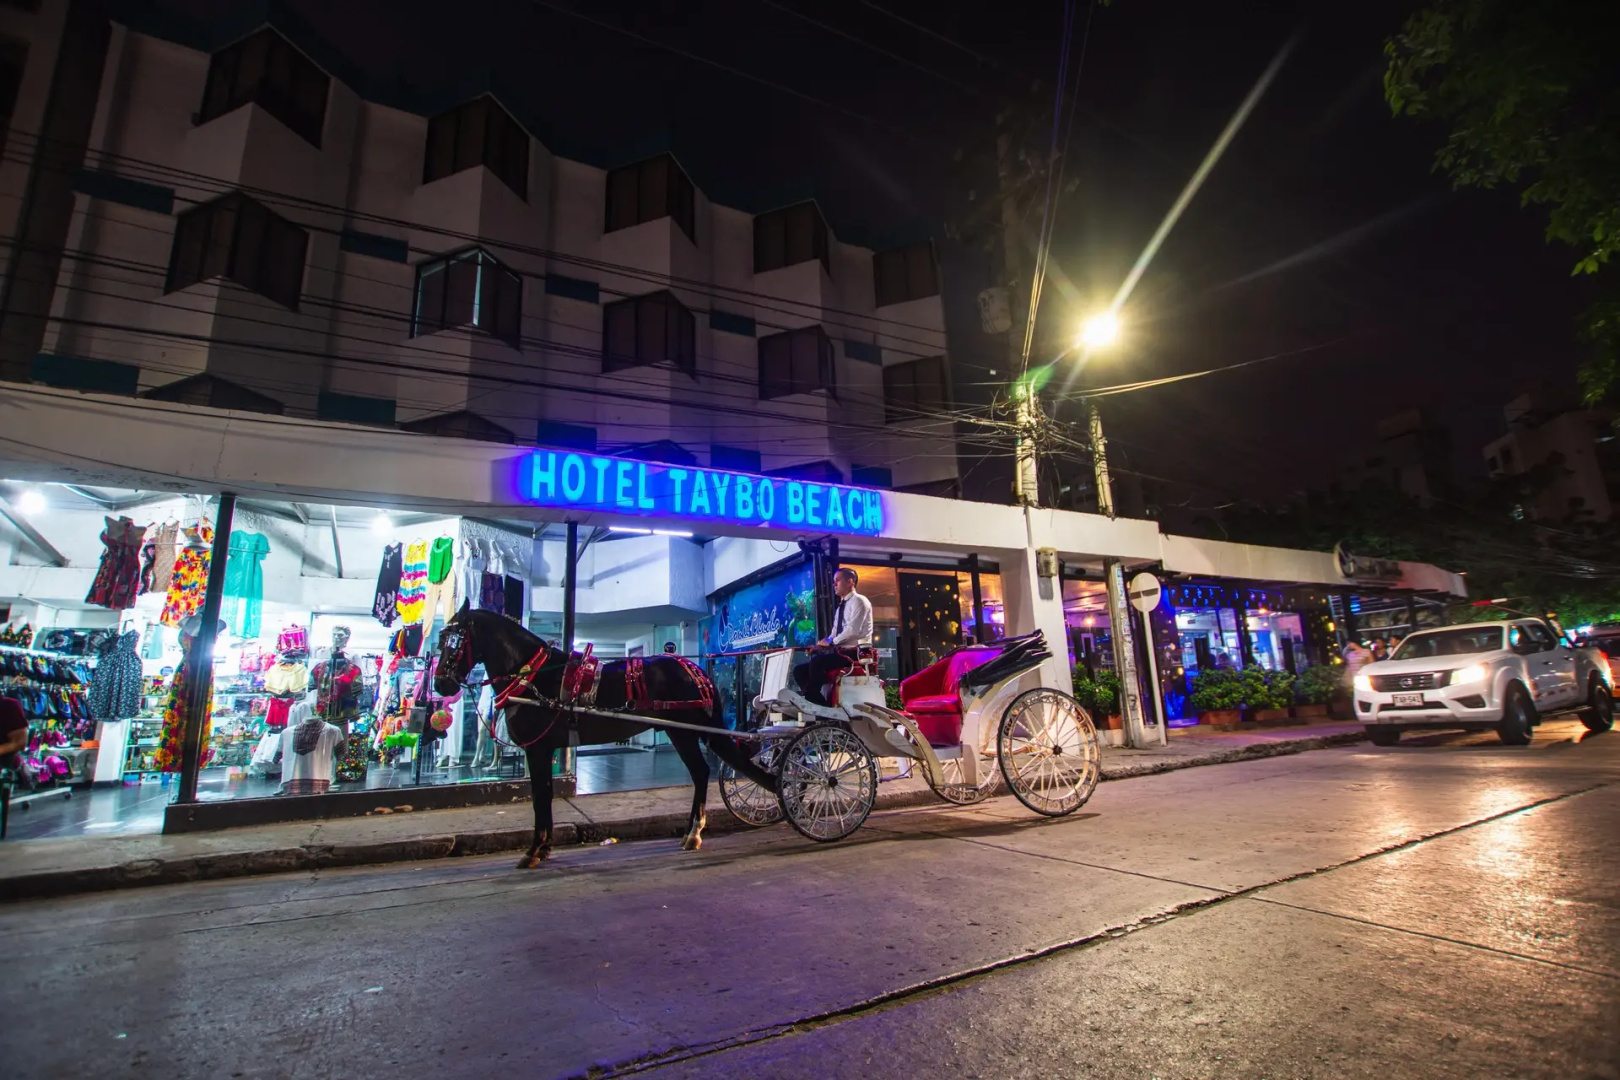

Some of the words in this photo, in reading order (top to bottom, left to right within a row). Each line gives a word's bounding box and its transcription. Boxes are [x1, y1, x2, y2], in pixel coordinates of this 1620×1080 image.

[531, 453, 655, 509] HOTEL
[669, 468, 775, 521] TAYBO
[787, 482, 882, 531] BEACH
